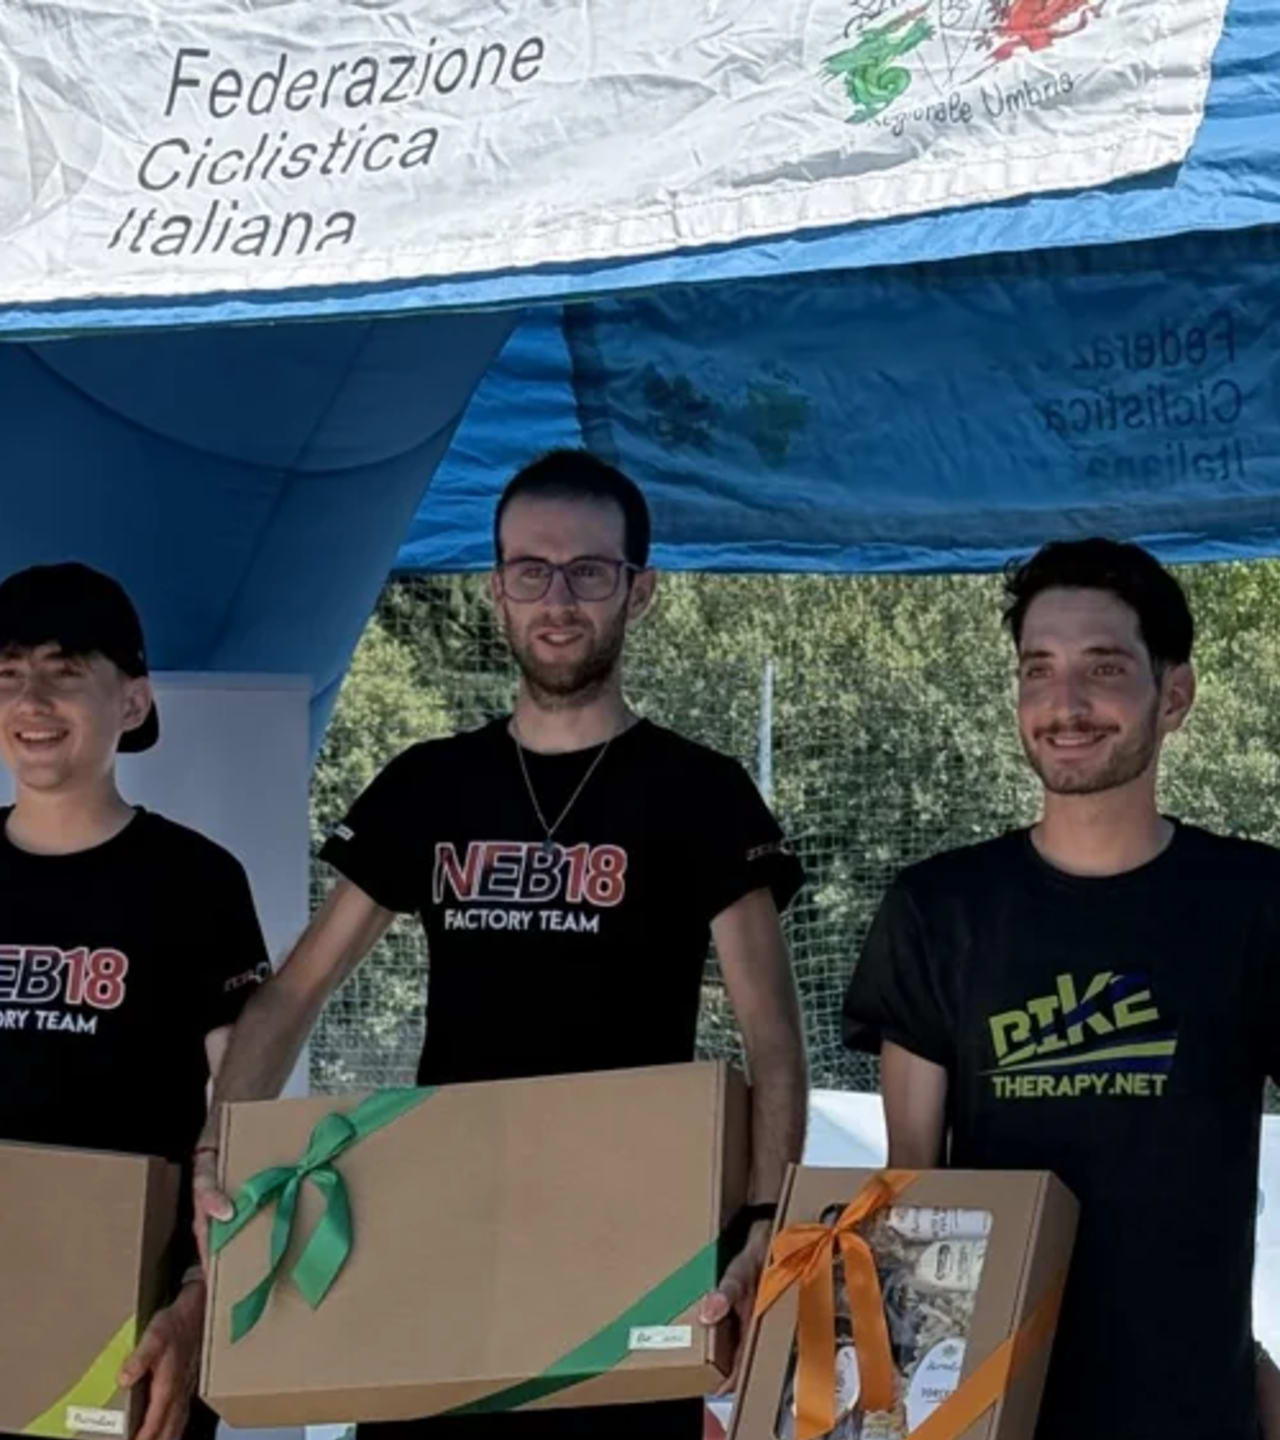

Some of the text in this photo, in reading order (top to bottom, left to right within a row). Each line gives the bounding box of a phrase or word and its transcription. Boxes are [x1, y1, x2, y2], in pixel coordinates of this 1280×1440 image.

[164, 35, 545, 119] Federazione
[137, 126, 439, 191] Ciclistica
[109, 199, 358, 257] Italiana
[433, 841, 628, 907] NEB18
[444, 909, 600, 934] FACTORY TEAM
[36, 1009, 98, 1036] TEAM
[991, 1073, 1169, 1098] THERAPY.NET
